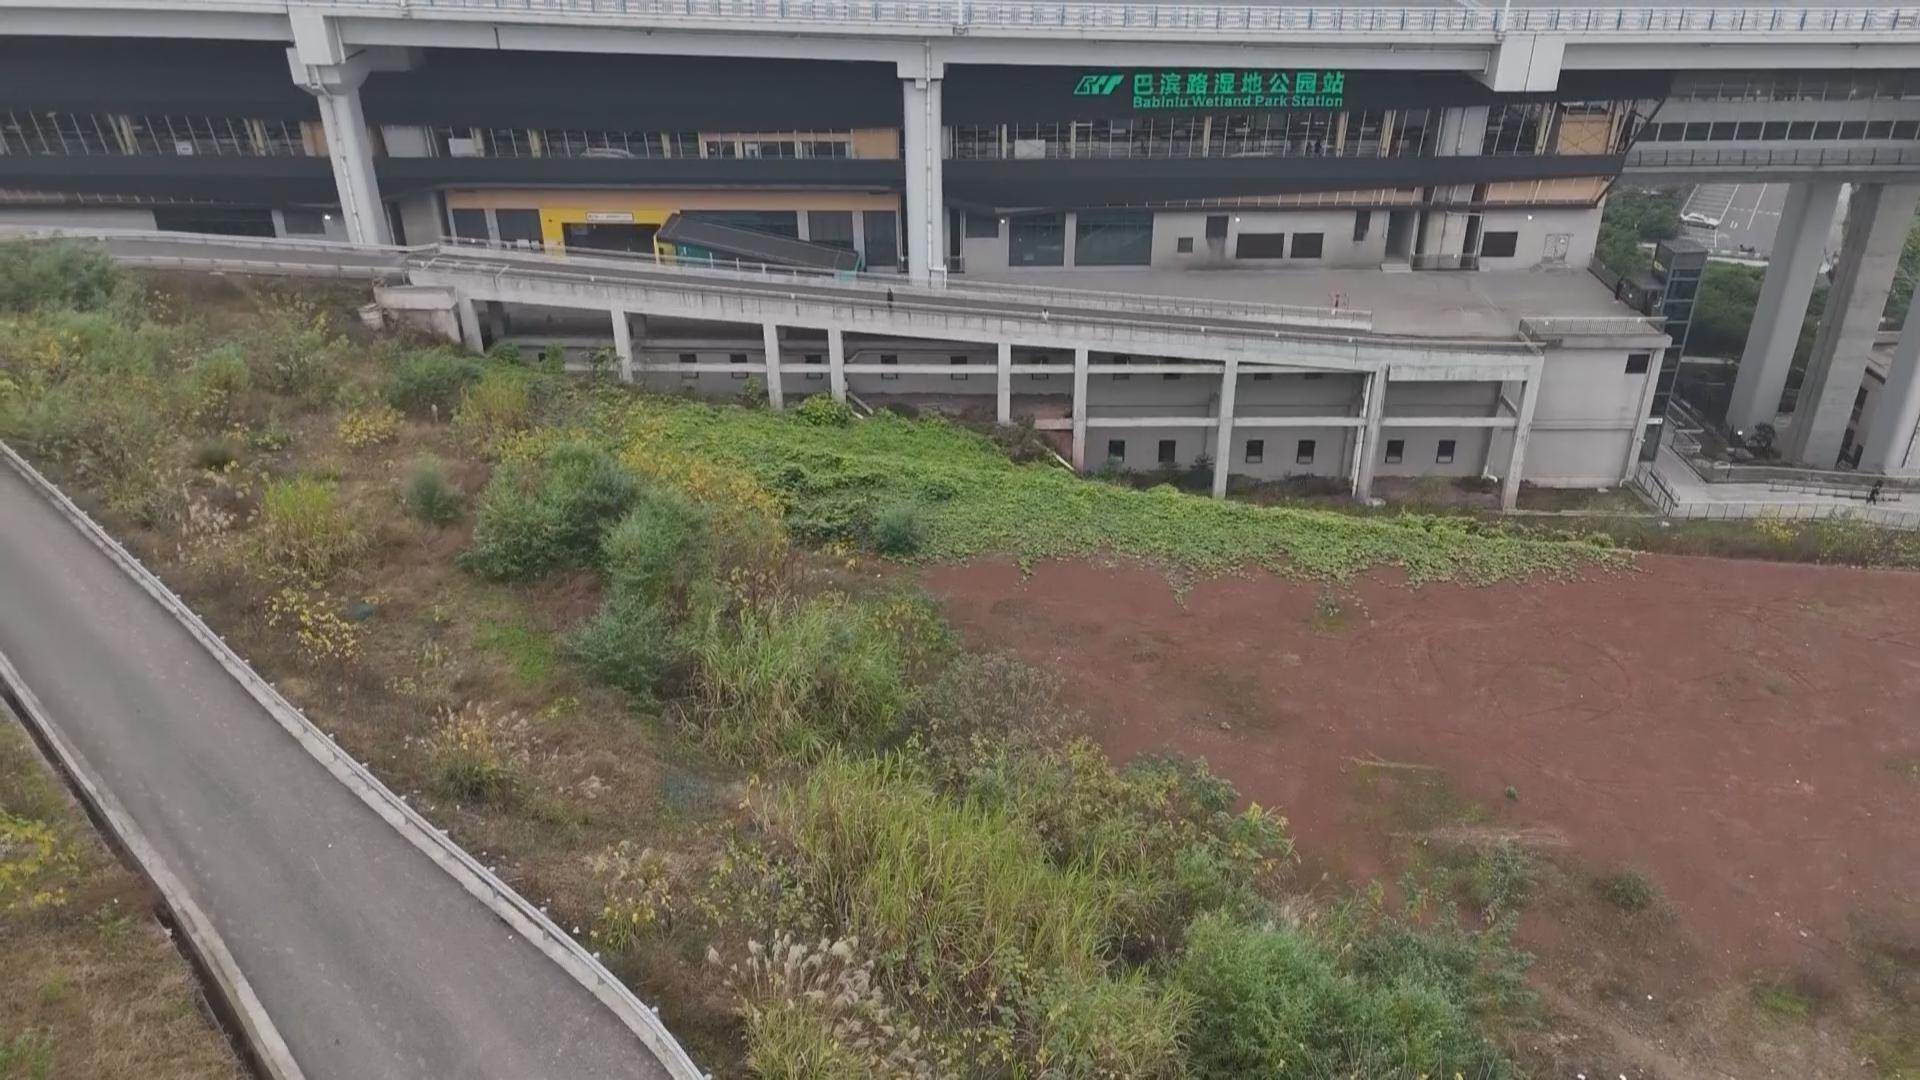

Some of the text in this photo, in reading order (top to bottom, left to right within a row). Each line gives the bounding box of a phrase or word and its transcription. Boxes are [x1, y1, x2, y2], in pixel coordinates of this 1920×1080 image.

[1134, 72, 1345, 95] 巴滨路湿地公园站
[1133, 95, 1343, 108] Babinlu Wetland Park Station
